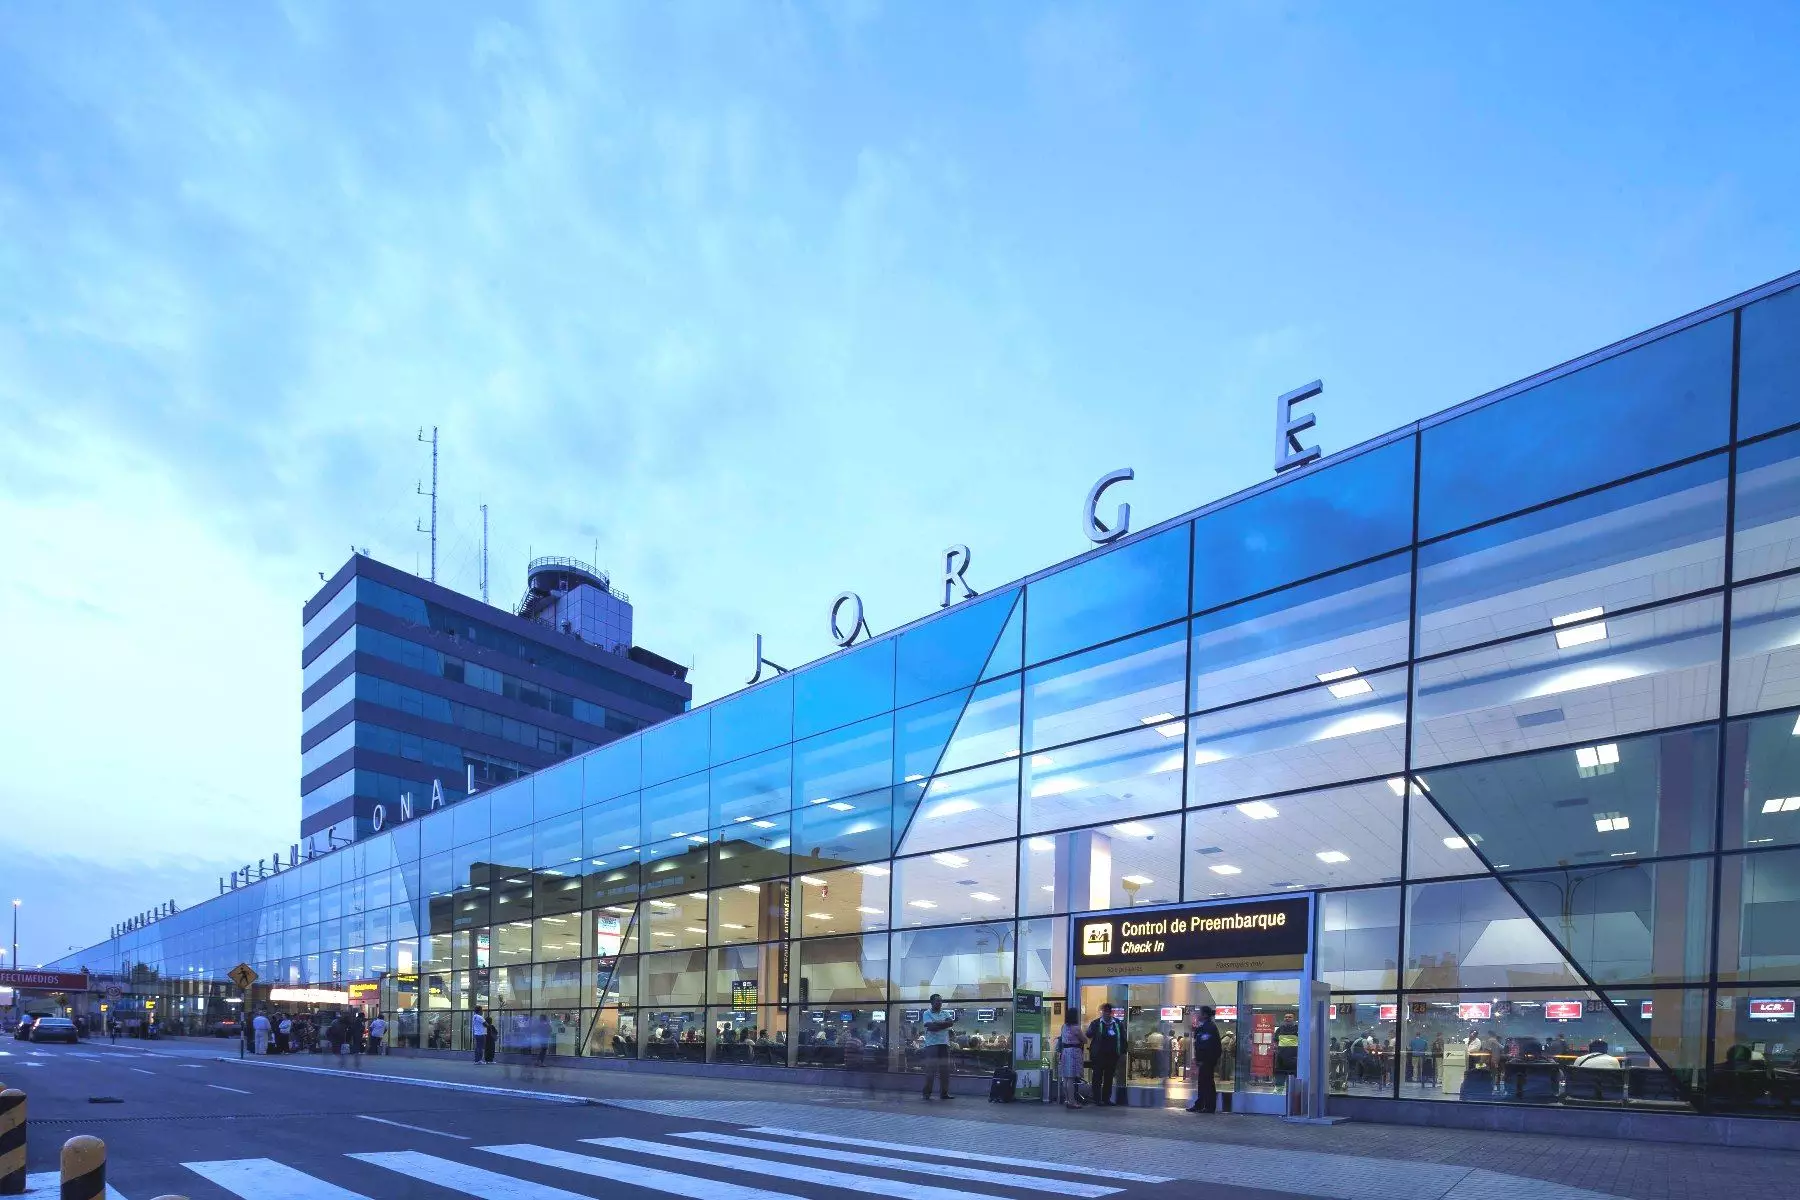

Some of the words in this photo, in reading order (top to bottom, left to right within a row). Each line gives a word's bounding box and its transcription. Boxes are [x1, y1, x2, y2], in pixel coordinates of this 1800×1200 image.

[744, 379, 1324, 685] JORGE
[1121, 919, 1167, 937] Control
[1171, 918, 1187, 934] de
[1190, 912, 1286, 932] Preembarque
[1121, 941, 1151, 954] Check
[1153, 940, 1165, 953] In
